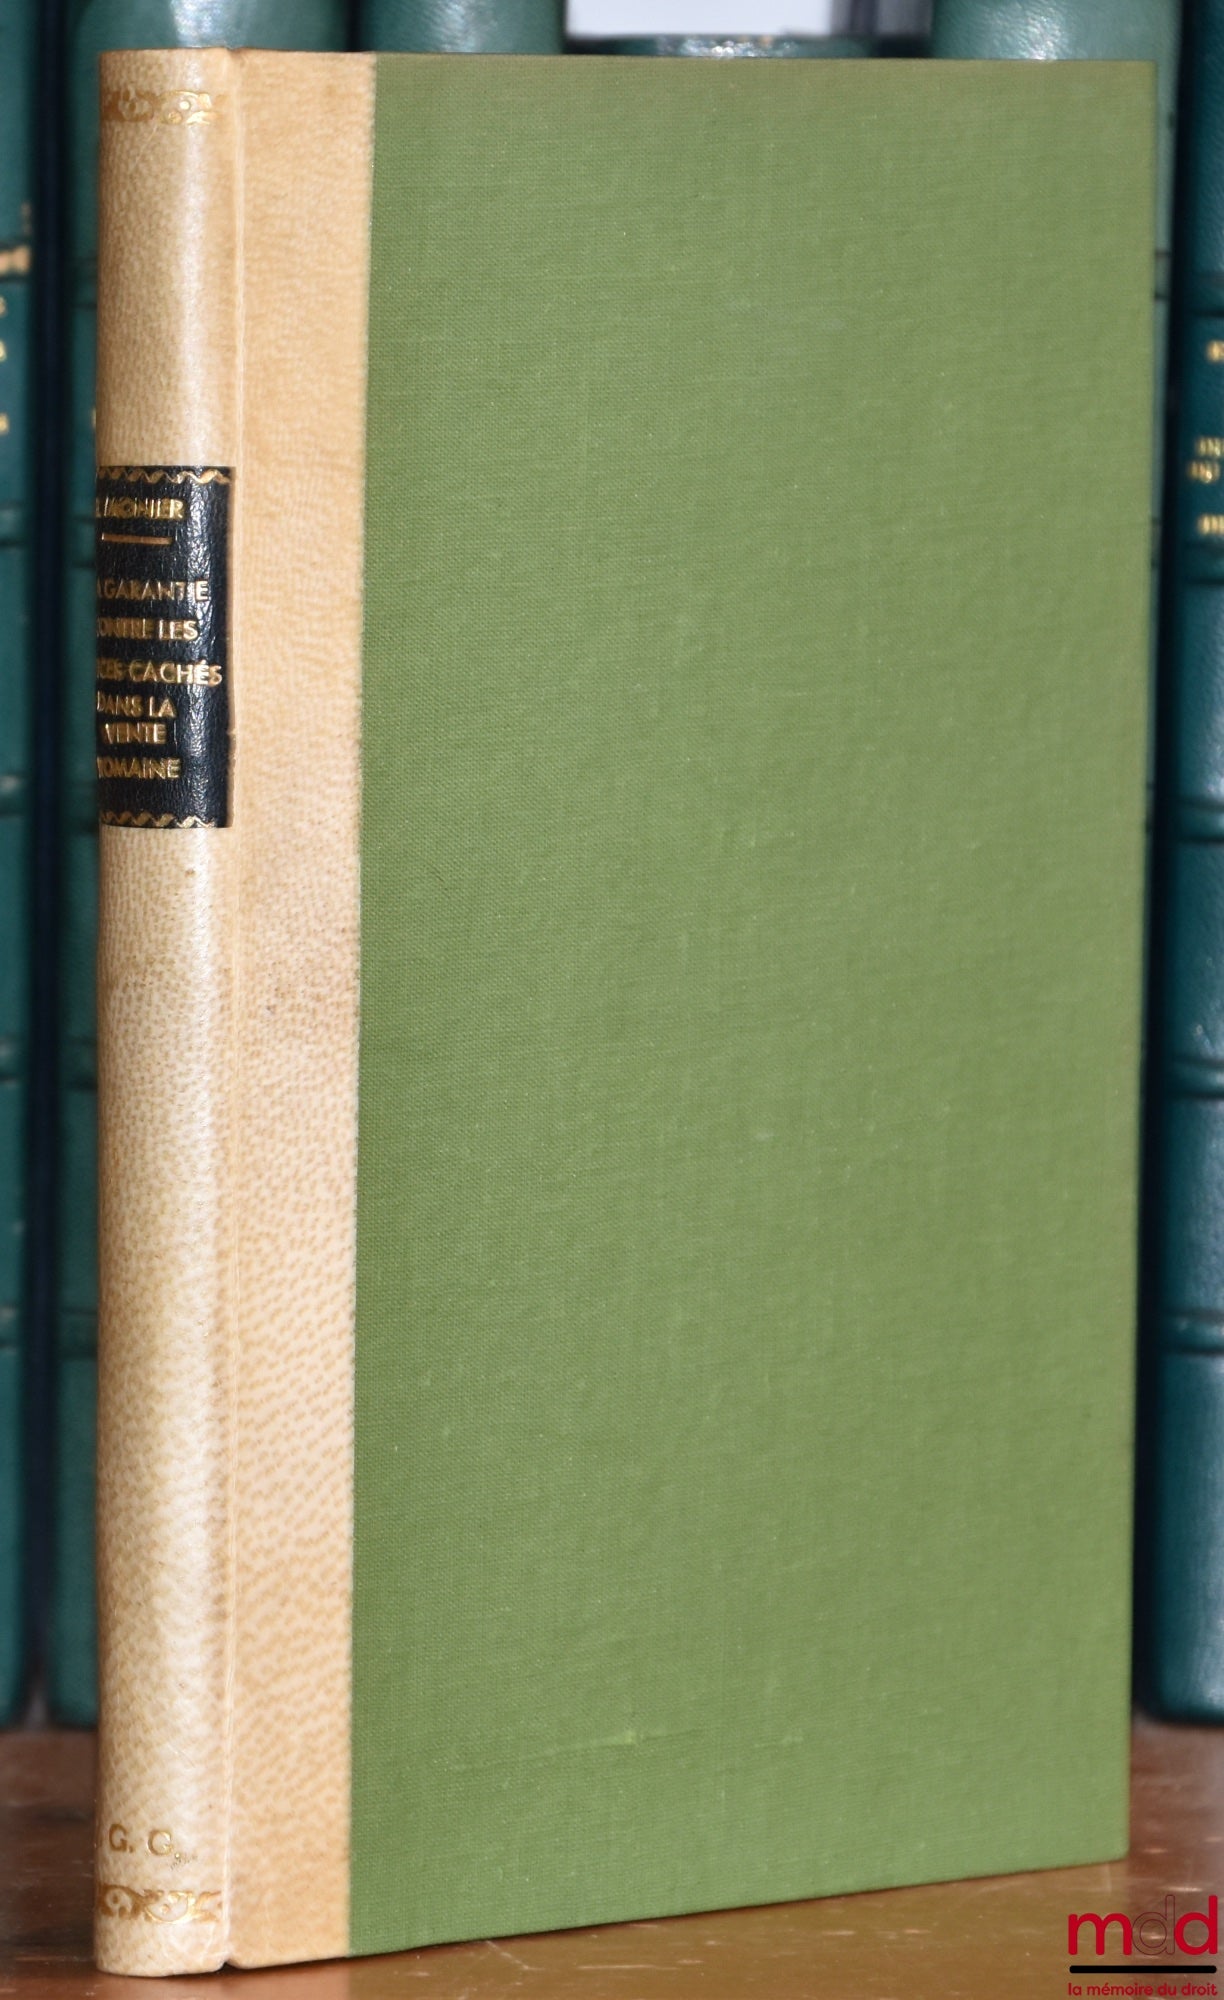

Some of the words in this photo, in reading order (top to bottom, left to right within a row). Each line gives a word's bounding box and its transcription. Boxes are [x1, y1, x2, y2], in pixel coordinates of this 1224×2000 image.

[158, 619, 199, 641] LES
[128, 658, 223, 687] CACHÉS
[149, 695, 177, 717] LA
[104, 722, 167, 745] VENTE
[108, 1823, 134, 1853] G.
